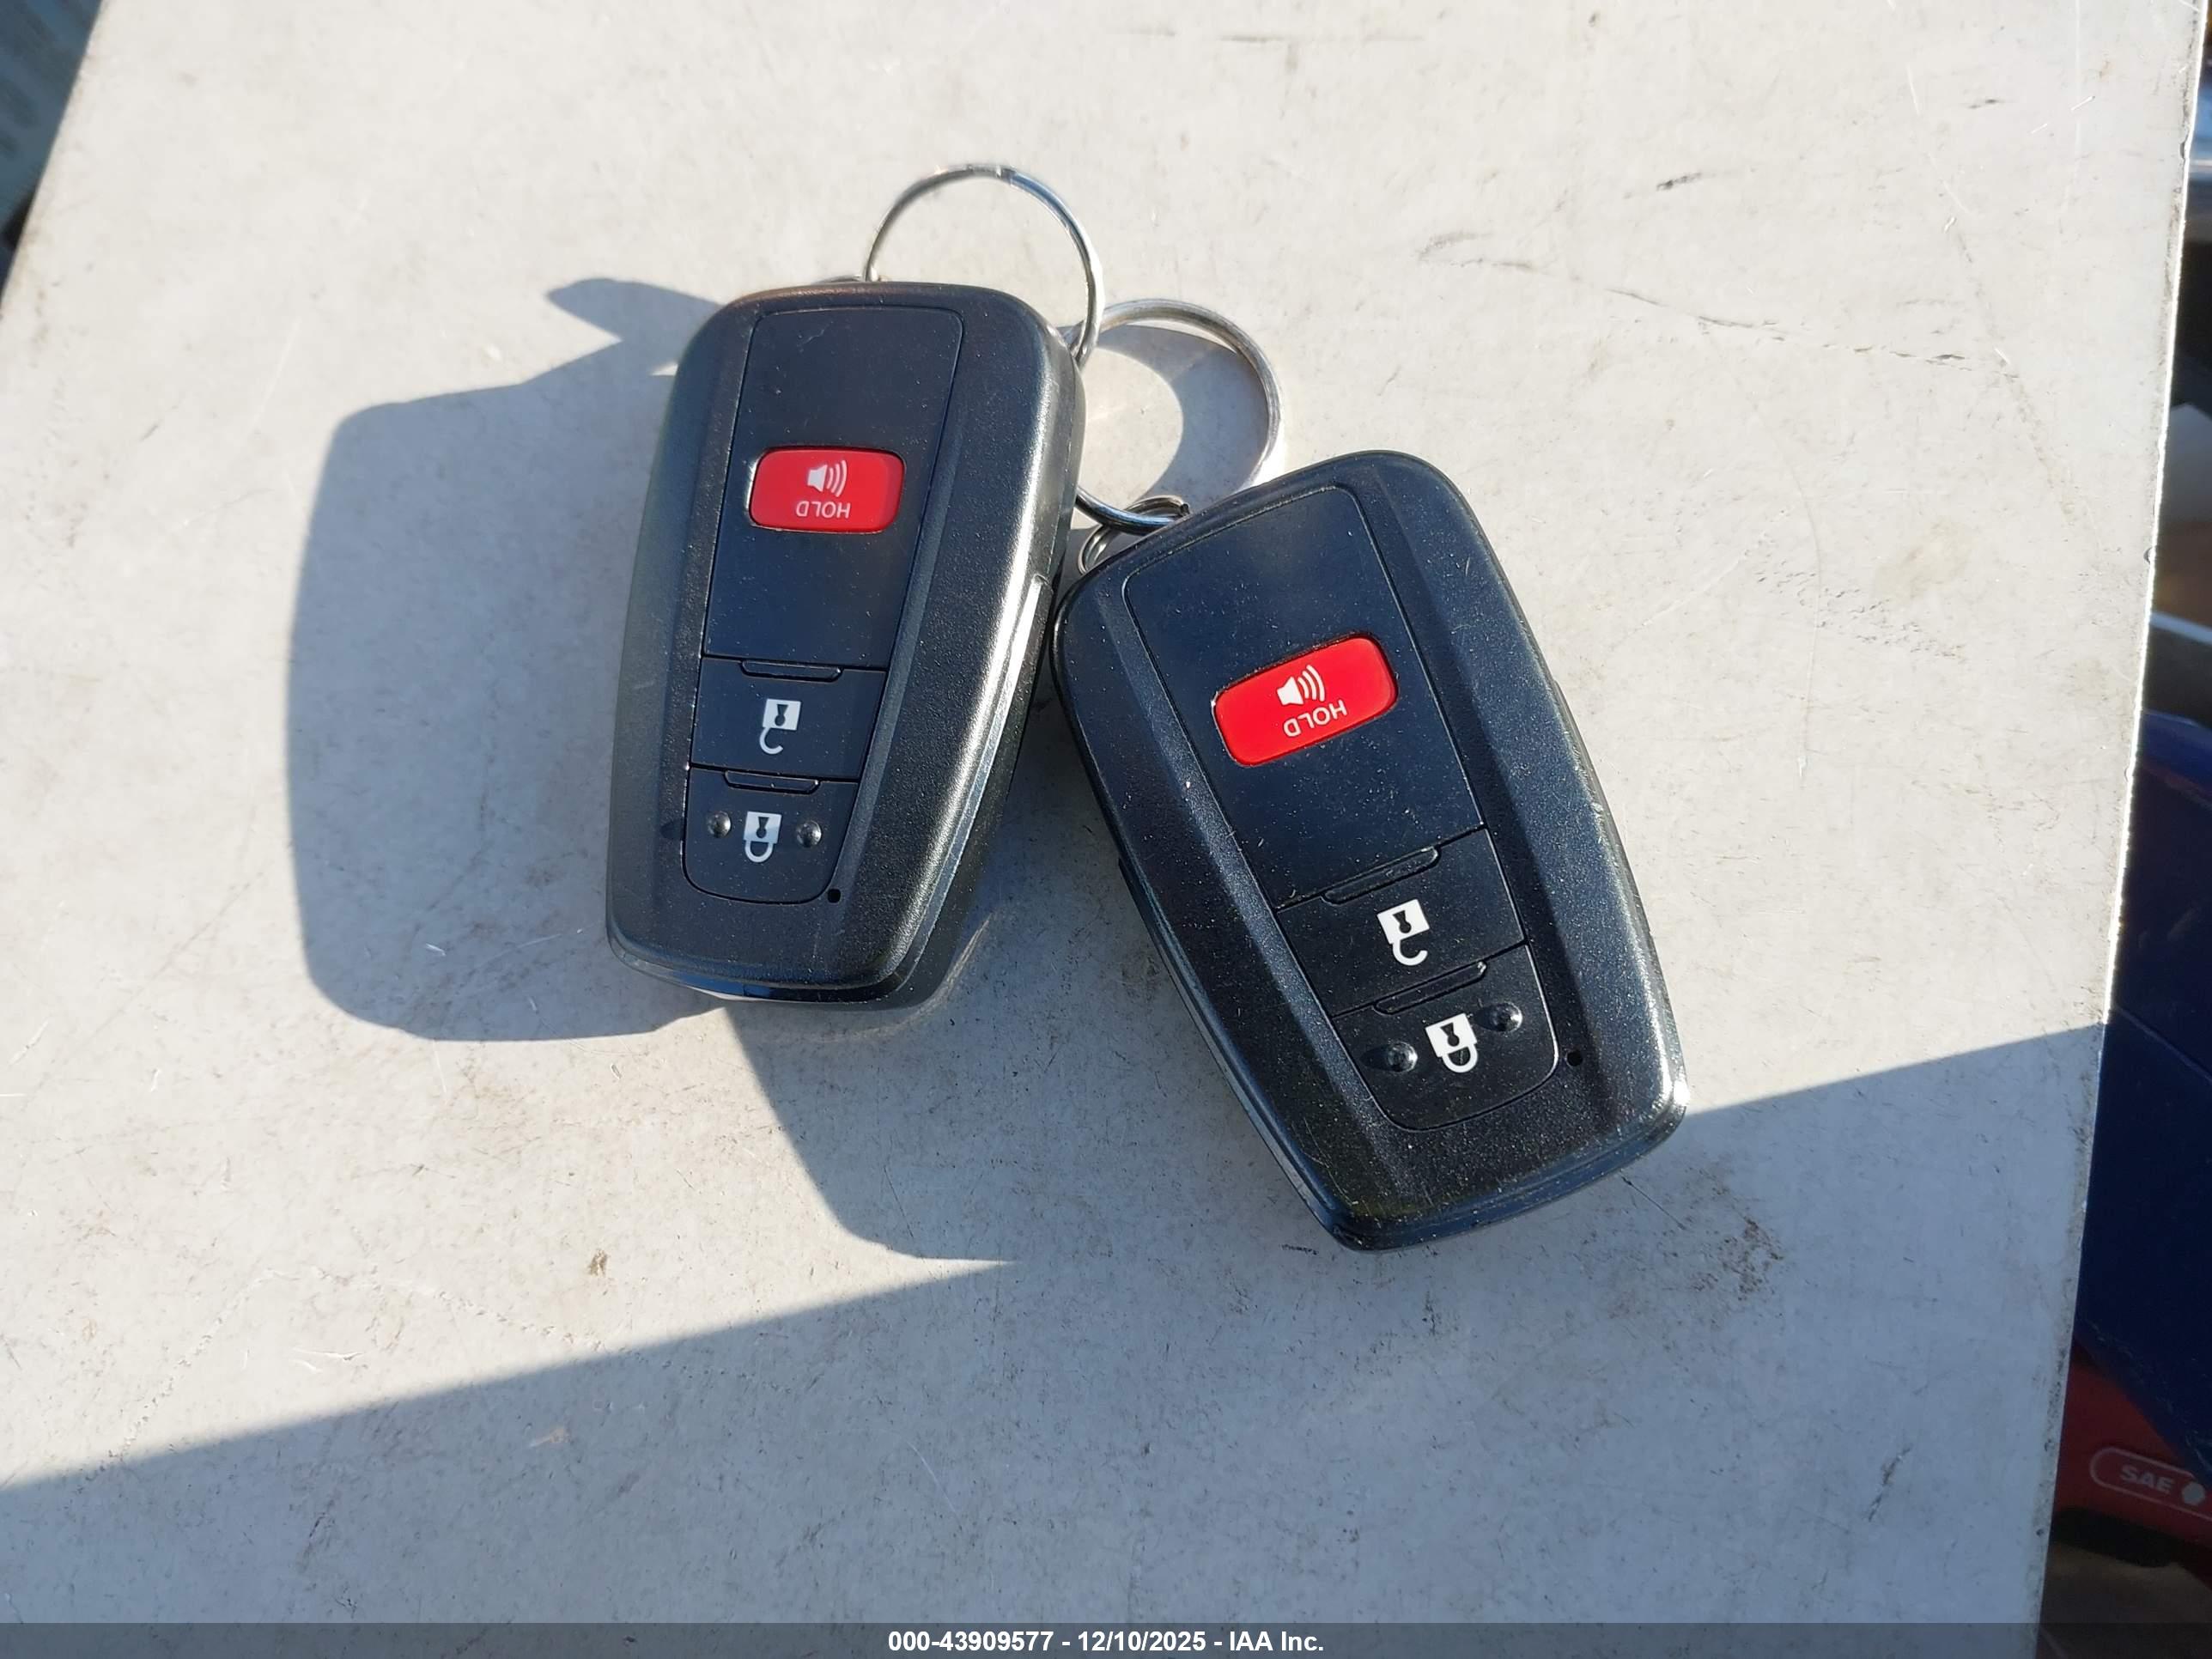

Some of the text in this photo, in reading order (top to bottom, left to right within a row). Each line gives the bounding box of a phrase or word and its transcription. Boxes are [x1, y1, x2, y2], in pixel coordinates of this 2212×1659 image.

[796, 501, 851, 519] HOLD
[1283, 699, 1348, 738] HOLD
[2119, 1463, 2174, 1495] SAE
